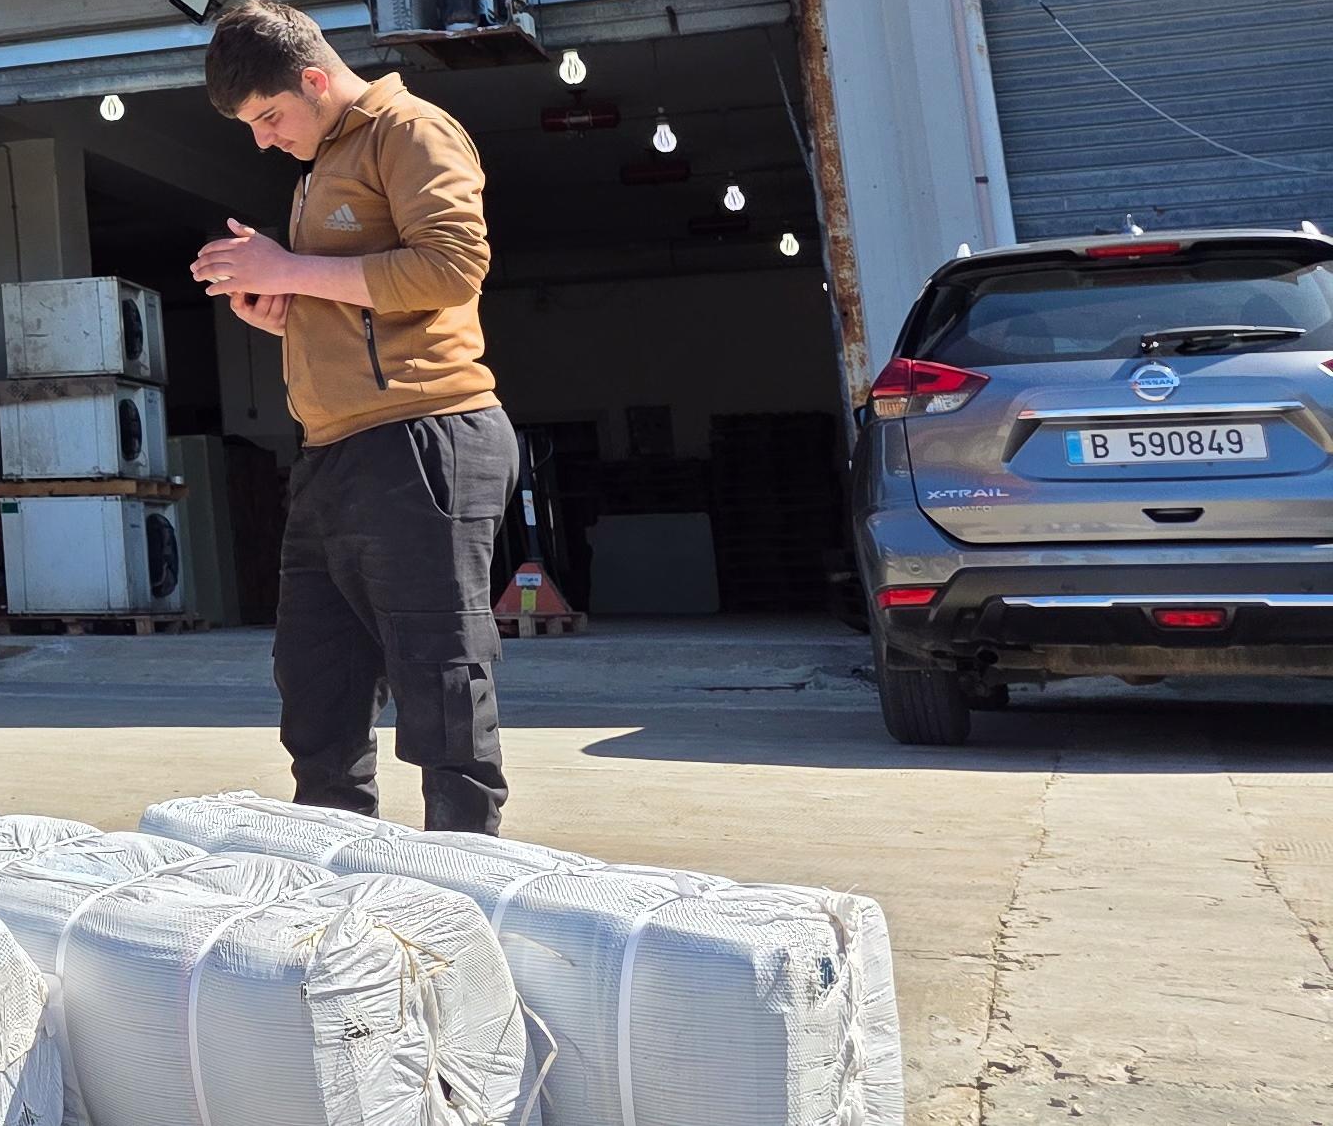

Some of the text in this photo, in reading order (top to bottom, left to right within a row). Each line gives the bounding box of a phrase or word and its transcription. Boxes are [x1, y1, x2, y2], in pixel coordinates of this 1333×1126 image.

[1090, 429, 1244, 459] B 590849
[926, 488, 1010, 500] X-TRAIL
